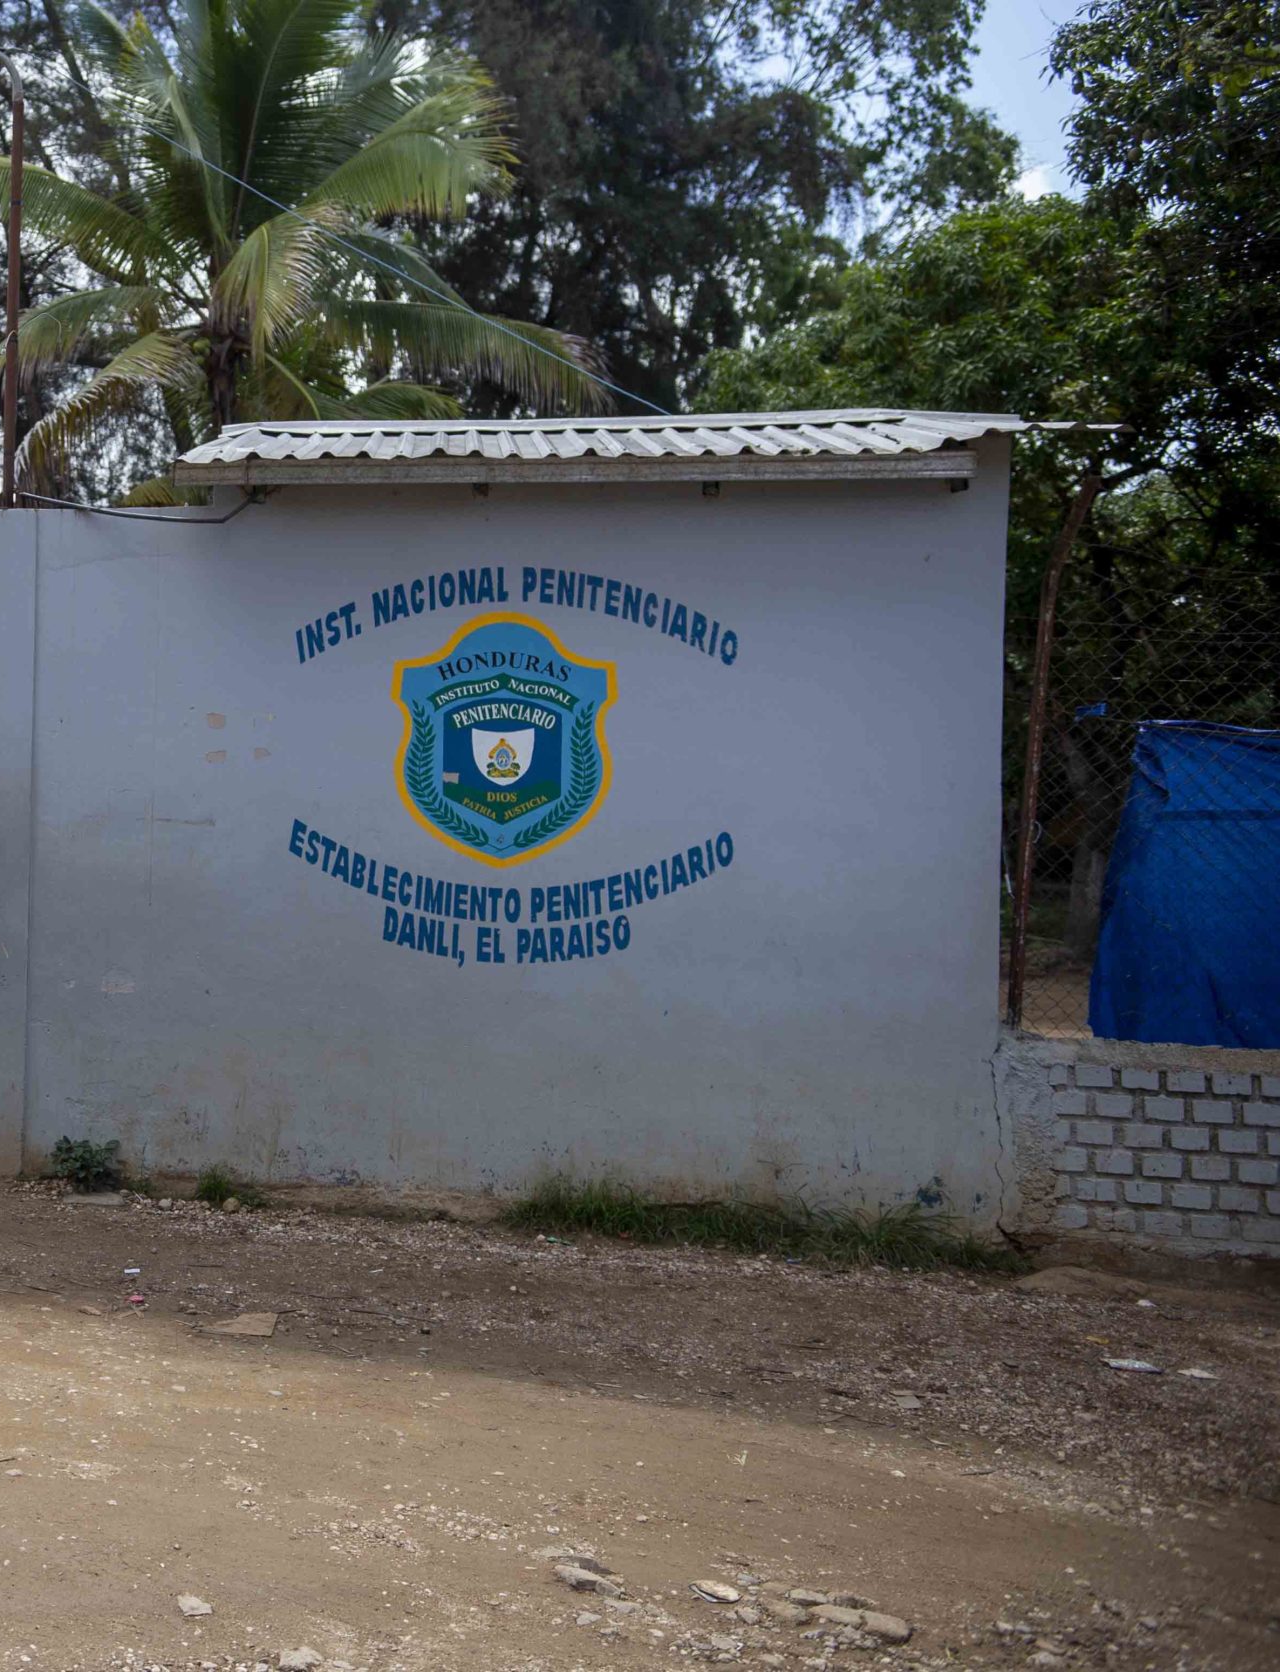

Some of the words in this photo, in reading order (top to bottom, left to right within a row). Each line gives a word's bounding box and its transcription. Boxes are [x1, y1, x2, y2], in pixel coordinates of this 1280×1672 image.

[295, 601, 362, 664] INST.
[371, 567, 509, 628] NACIONAL
[521, 566, 739, 666] PENITENCIARIO
[437, 651, 571, 682] HONDURAS
[435, 680, 500, 706] INSTITUTO
[508, 678, 571, 706] NACIONAL
[452, 703, 556, 730] PENITENCIARIO
[463, 797, 496, 819] PATRIA
[503, 795, 548, 820] JUSTICIA
[486, 791, 517, 802] DIOS
[288, 818, 520, 923] ESTABLECIMIENTO
[530, 831, 735, 923] PENITENCIARIO
[382, 906, 465, 968] DANLI,
[476, 927, 505, 963] EL
[517, 915, 631, 964] PARAISO
